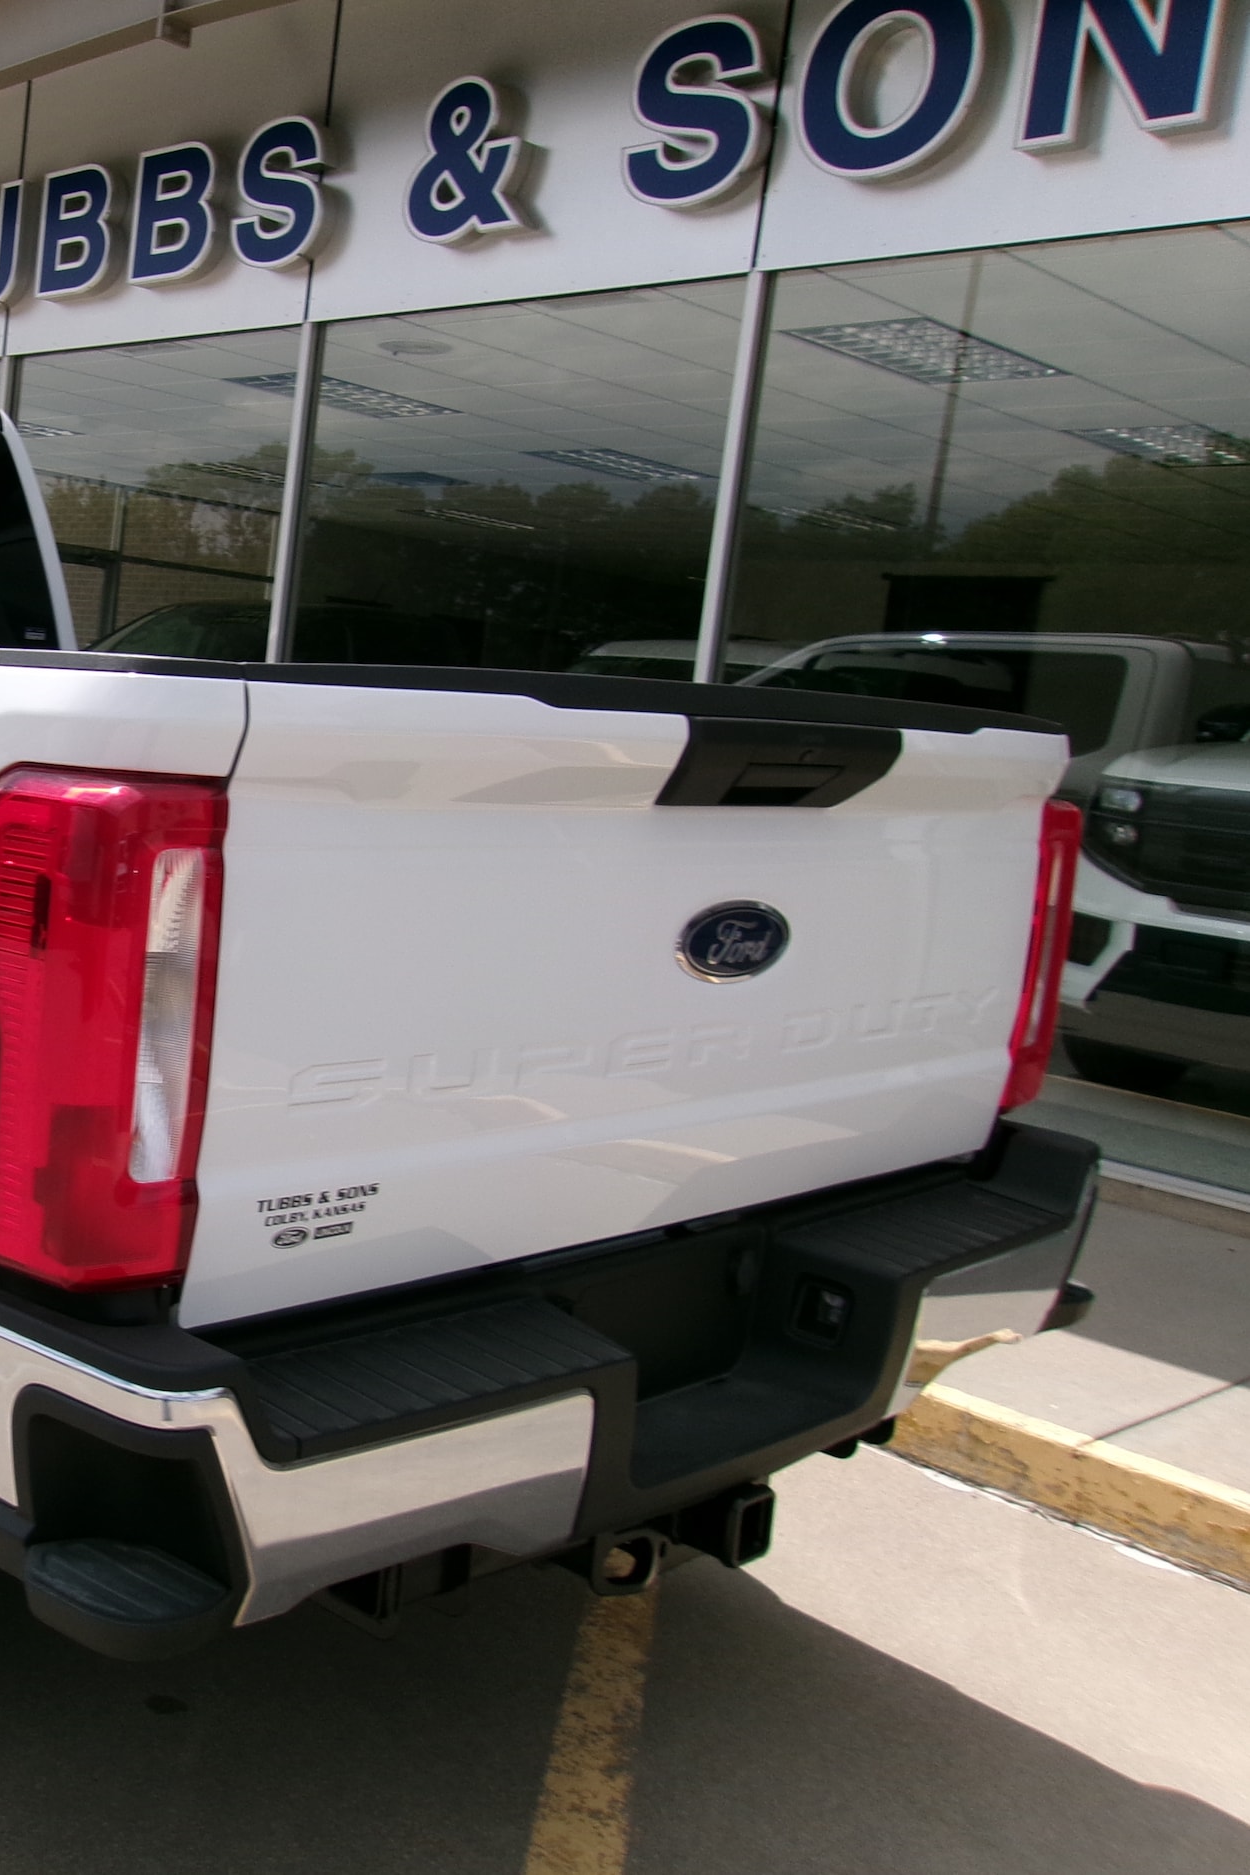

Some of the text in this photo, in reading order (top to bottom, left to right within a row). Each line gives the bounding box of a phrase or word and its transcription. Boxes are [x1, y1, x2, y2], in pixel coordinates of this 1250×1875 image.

[404, 75, 528, 247] &
[707, 919, 772, 965] Ford
[287, 986, 998, 1112] SUPER DUTY
[257, 1182, 380, 1213] TUBBS & SONS
[312, 1201, 366, 1220] KANSAS
